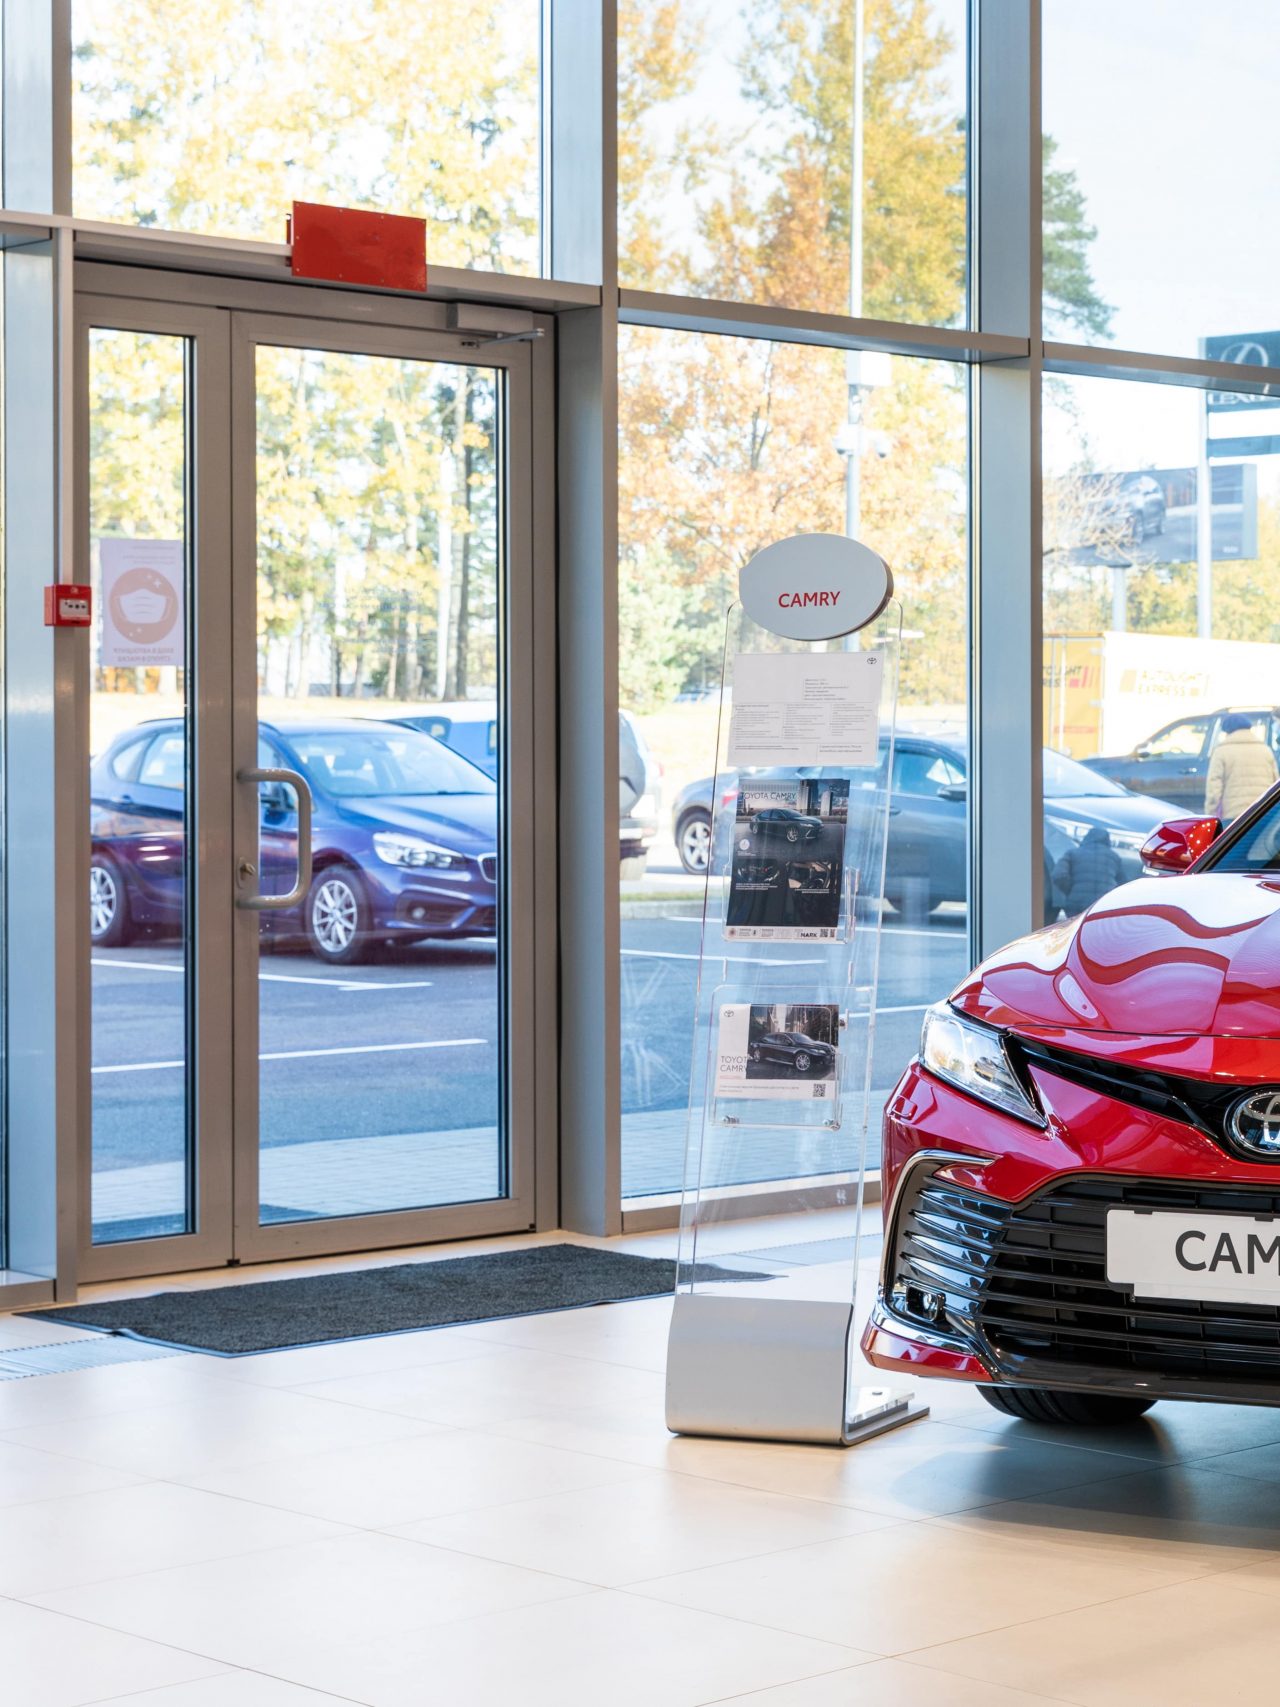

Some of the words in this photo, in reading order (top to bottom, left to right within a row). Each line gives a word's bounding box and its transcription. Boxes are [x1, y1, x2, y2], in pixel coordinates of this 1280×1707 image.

[778, 591, 841, 608] CAMRY
[740, 791, 769, 800] TOYOTA
[770, 791, 797, 801] CAMRY
[720, 1055, 749, 1063] TOYOT
